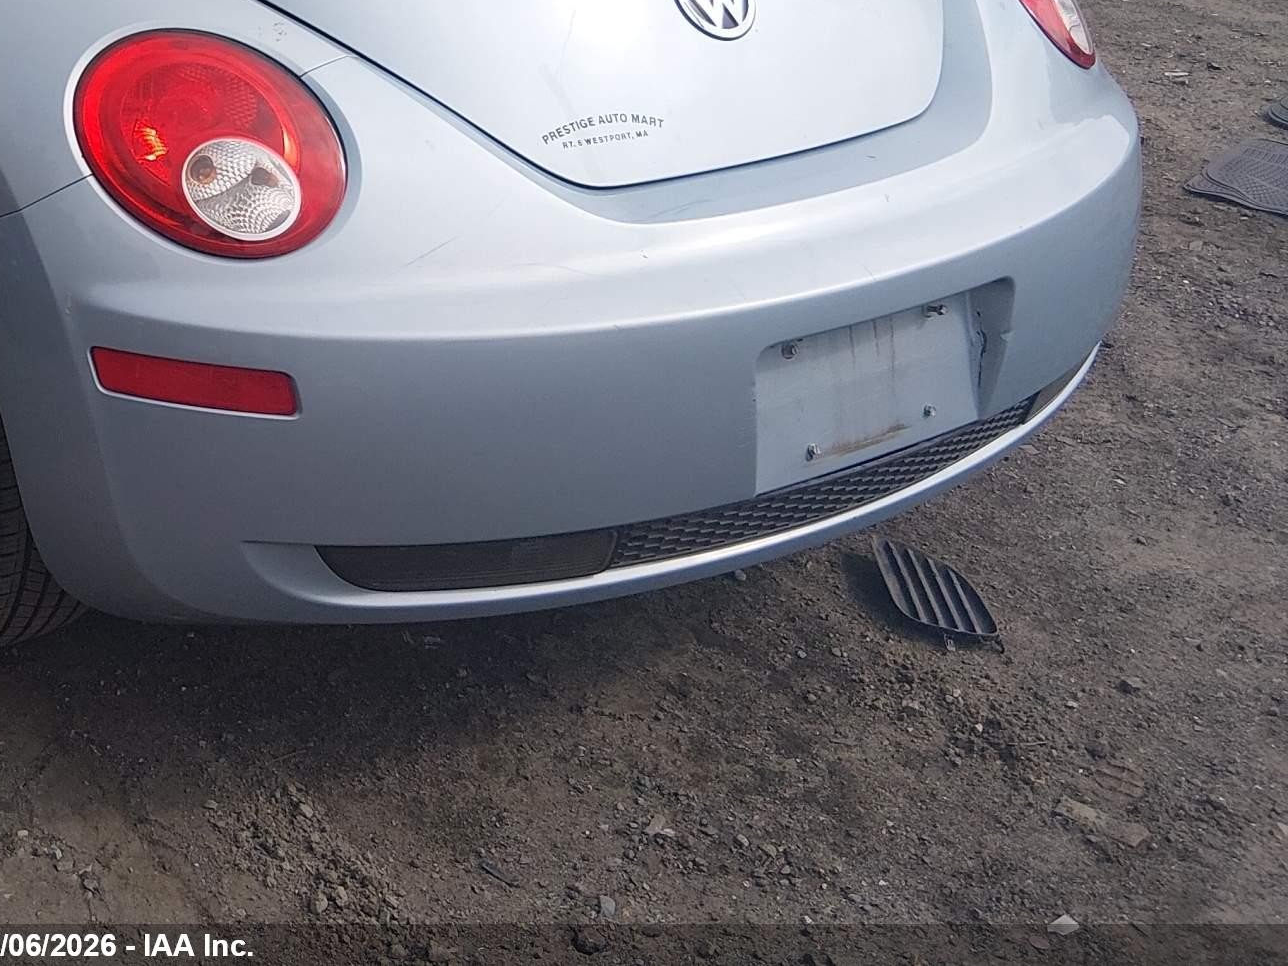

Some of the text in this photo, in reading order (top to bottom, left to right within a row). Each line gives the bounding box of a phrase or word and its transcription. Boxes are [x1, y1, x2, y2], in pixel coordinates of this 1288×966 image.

[541, 113, 665, 145] PRESTIGE AUTO MART
[636, 129, 649, 138] MA
